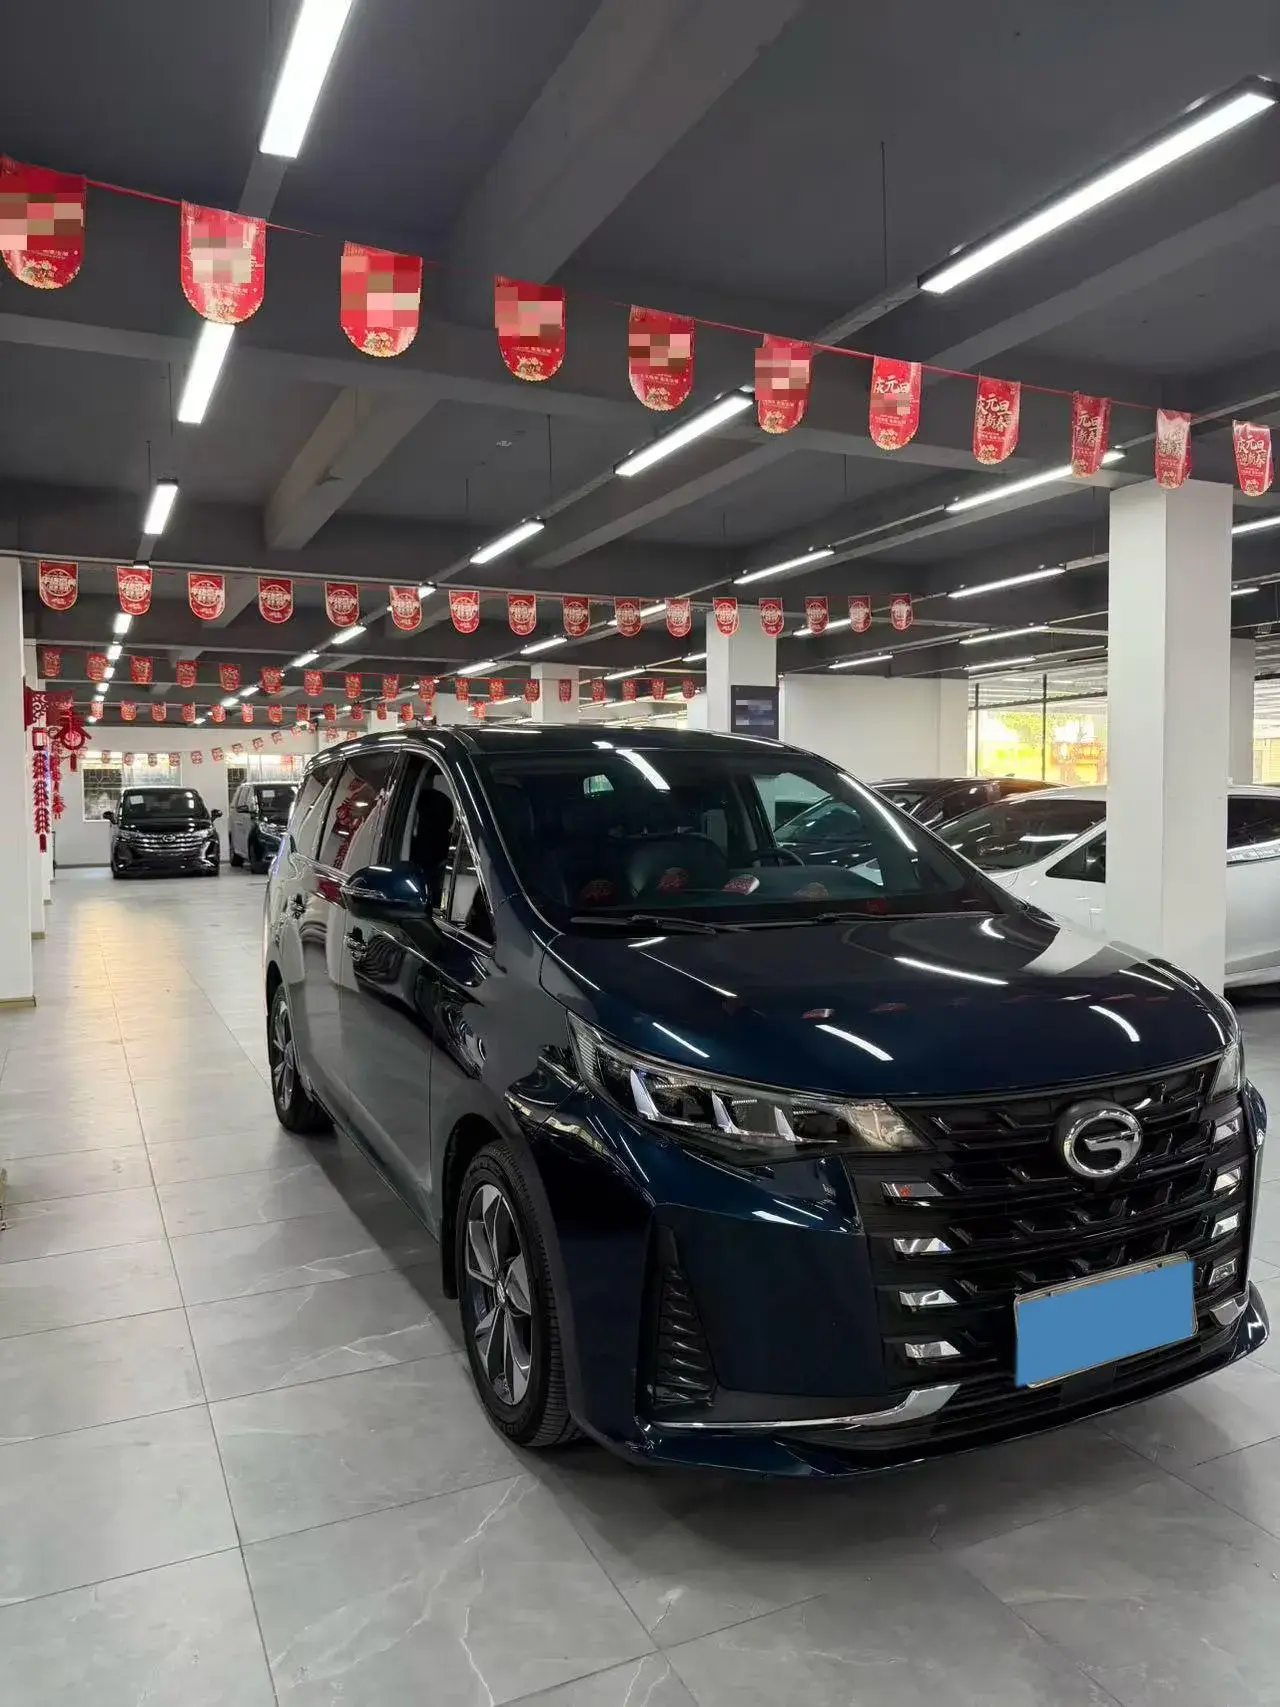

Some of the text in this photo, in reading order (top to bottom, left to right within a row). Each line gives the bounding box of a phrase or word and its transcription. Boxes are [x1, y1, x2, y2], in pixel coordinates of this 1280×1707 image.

[976, 393, 1012, 415] 庆元旦
[1237, 435, 1266, 454] 庆元旦
